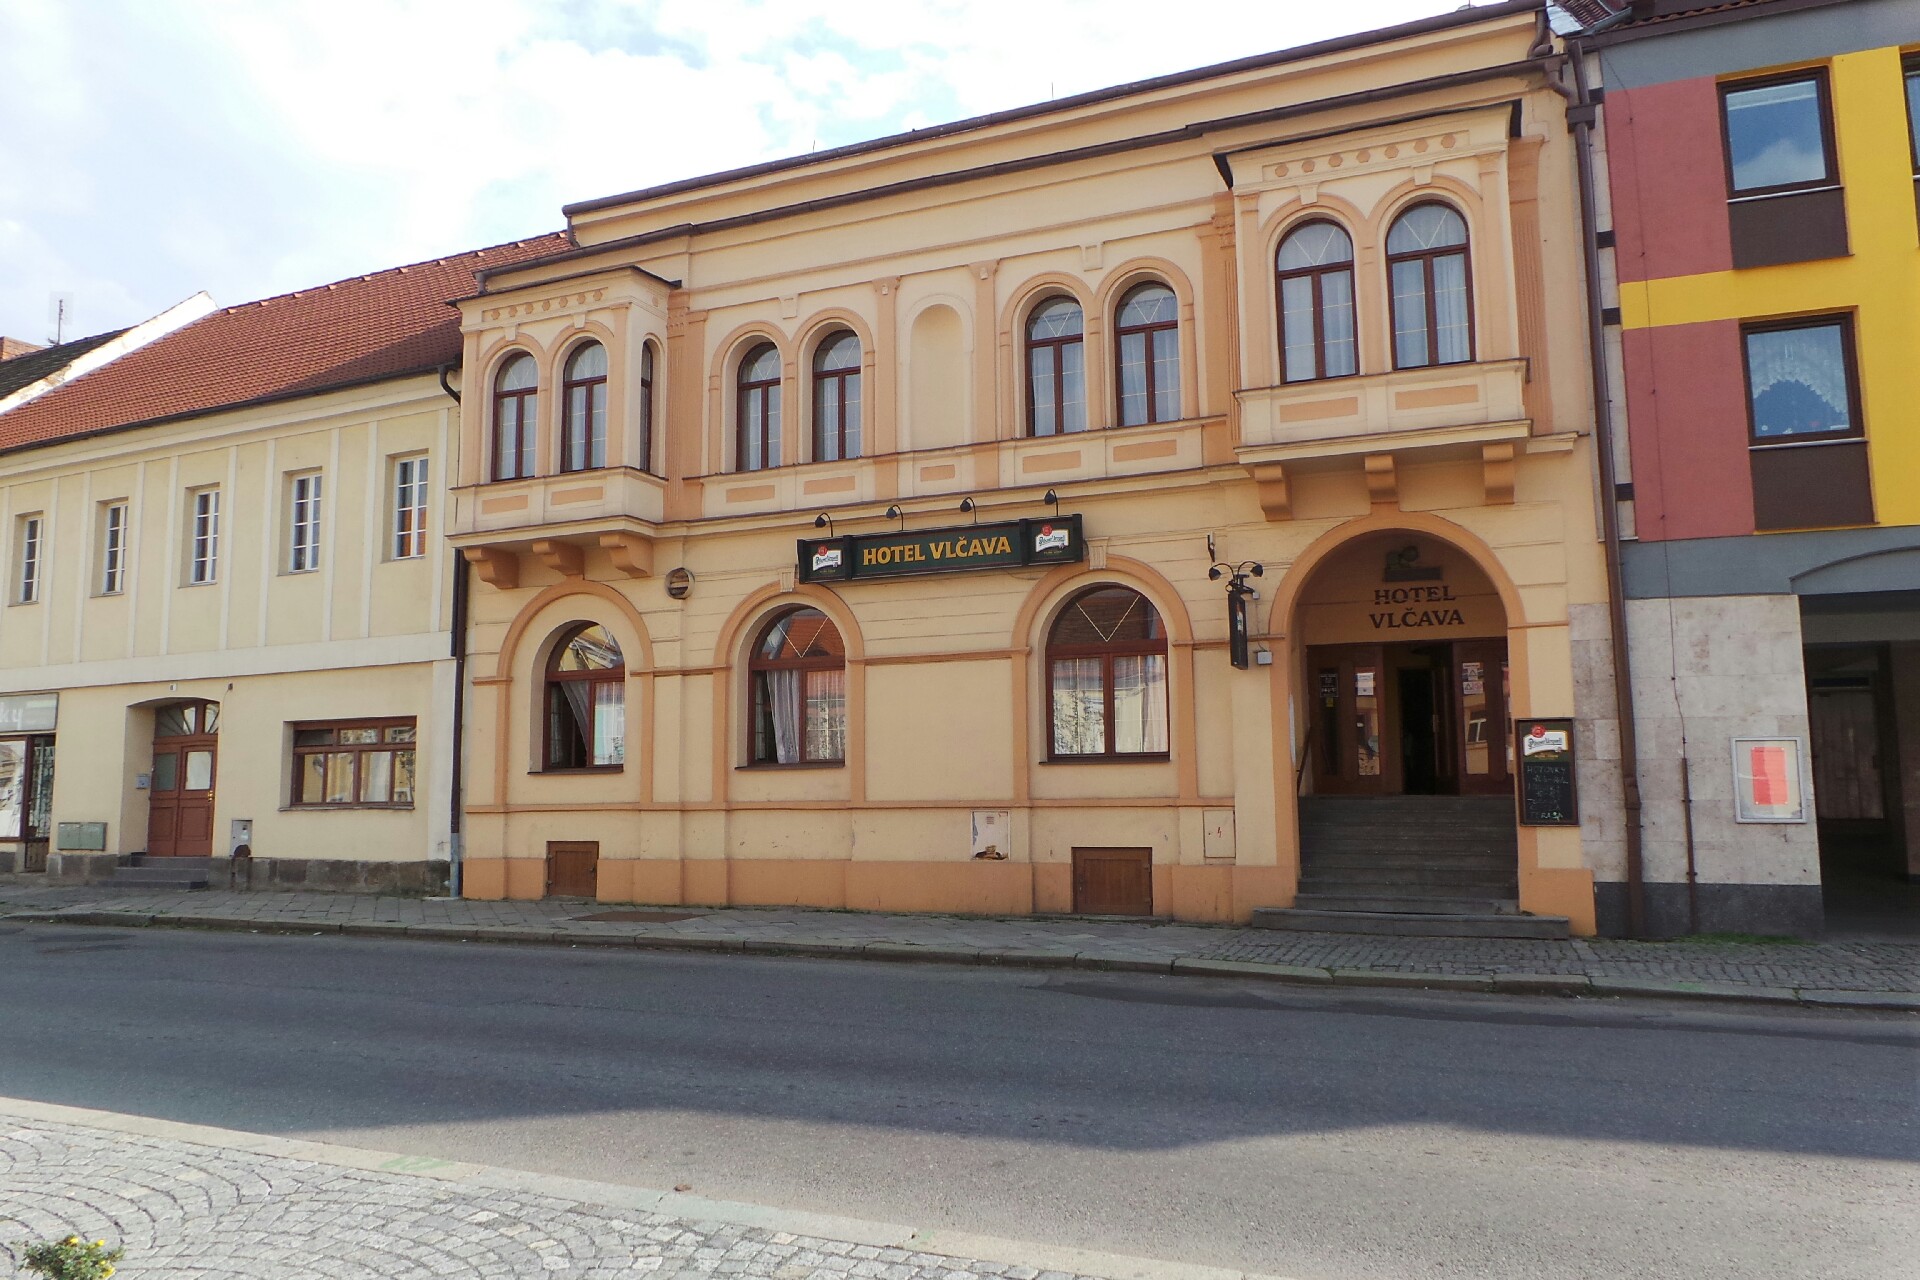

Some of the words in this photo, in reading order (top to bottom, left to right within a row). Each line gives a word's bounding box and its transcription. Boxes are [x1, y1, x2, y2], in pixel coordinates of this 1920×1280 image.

[863, 543, 926, 566] HOTEL
[929, 536, 1012, 560] VLČAVA
[1374, 585, 1457, 606] HOTEL
[1368, 607, 1465, 629] VLČAVA
